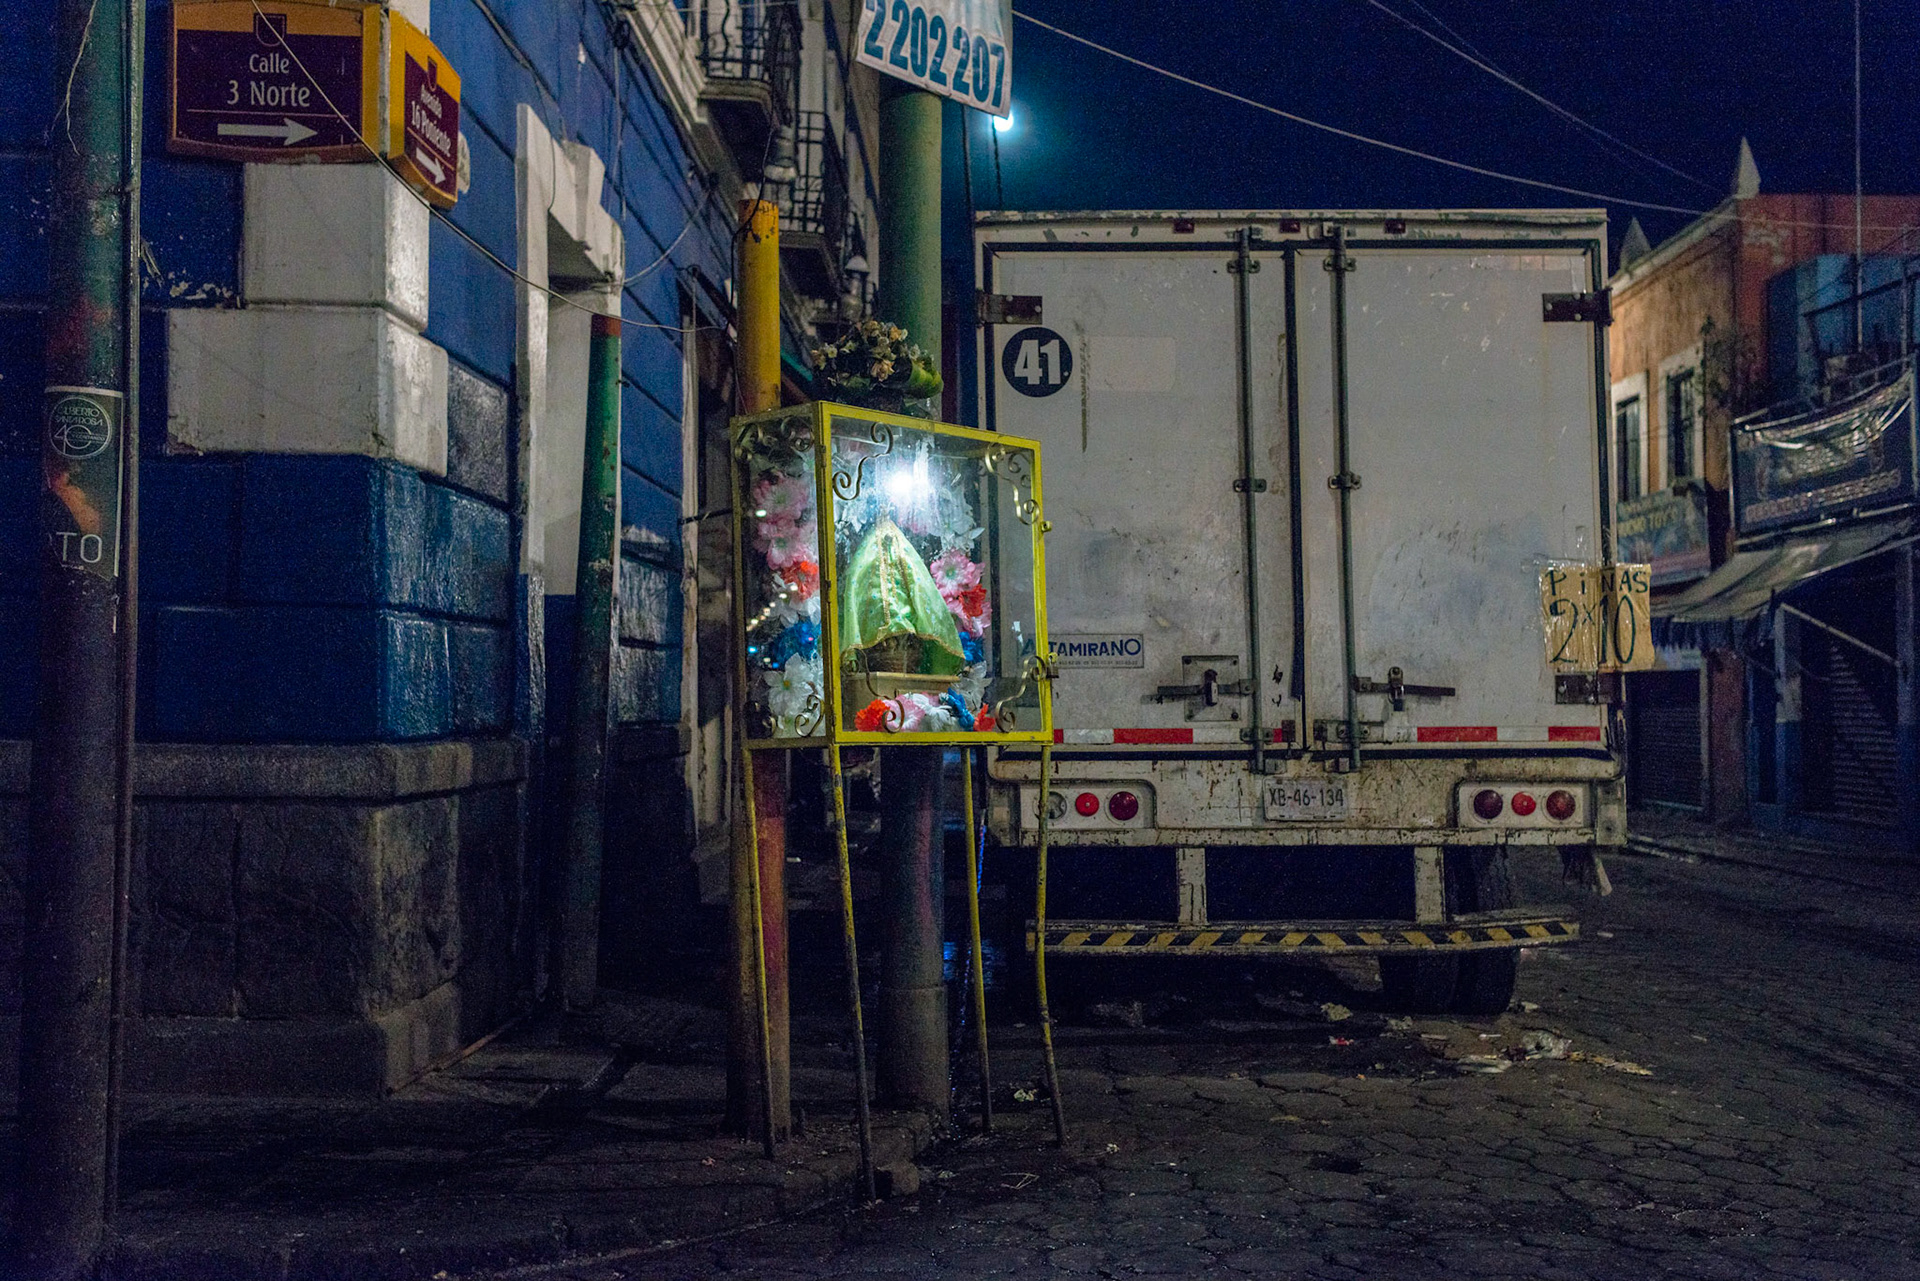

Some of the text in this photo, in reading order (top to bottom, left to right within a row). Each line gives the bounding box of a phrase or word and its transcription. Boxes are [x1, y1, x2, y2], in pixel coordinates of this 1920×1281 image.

[249, 53, 290, 74] Calle
[227, 79, 310, 107] 3 Norte
[421, 109, 452, 157] Poniente
[1014, 339, 1061, 385] 41
[1021, 638, 1141, 657] ATAMIRANO
[1269, 788, 1344, 806] XB-46-134
